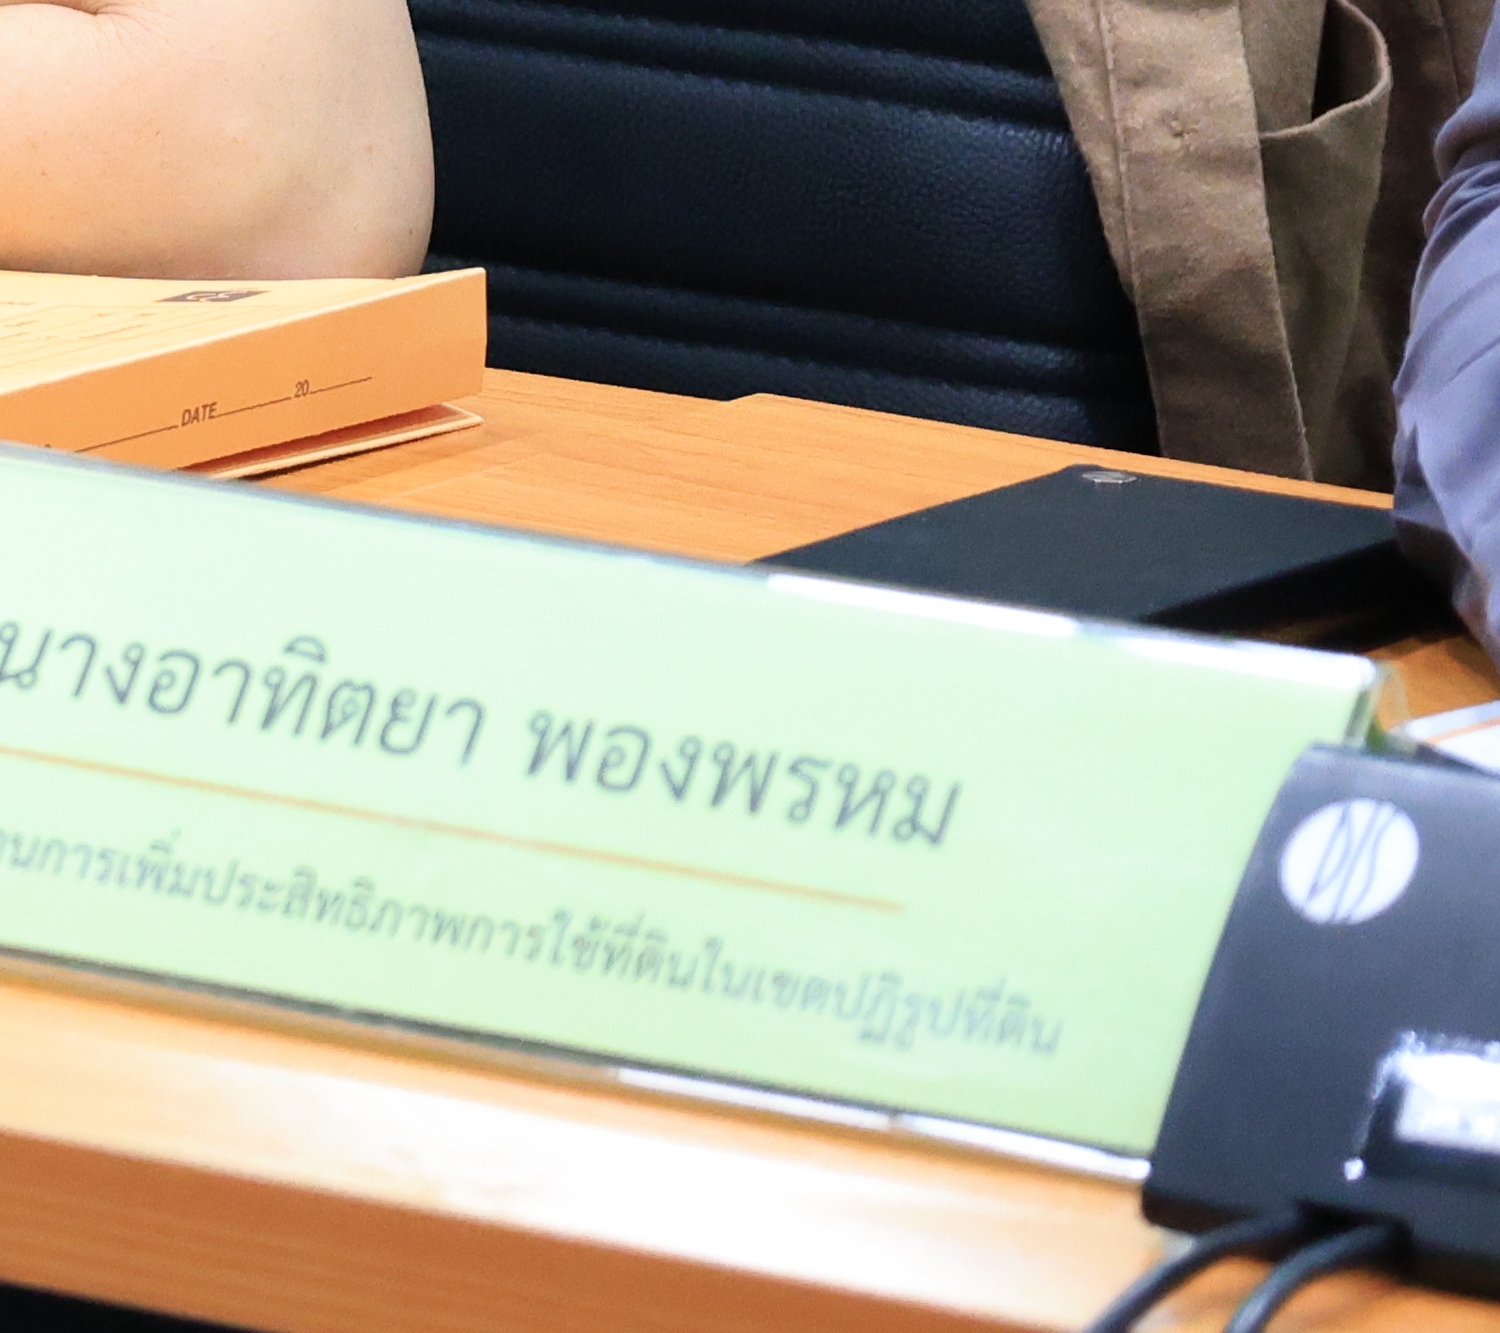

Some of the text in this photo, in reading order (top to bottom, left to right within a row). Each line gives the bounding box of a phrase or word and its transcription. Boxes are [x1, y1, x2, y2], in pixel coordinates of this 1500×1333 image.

[181, 379, 311, 428] DATE 20
[528, 713, 960, 849] พองพรหม
